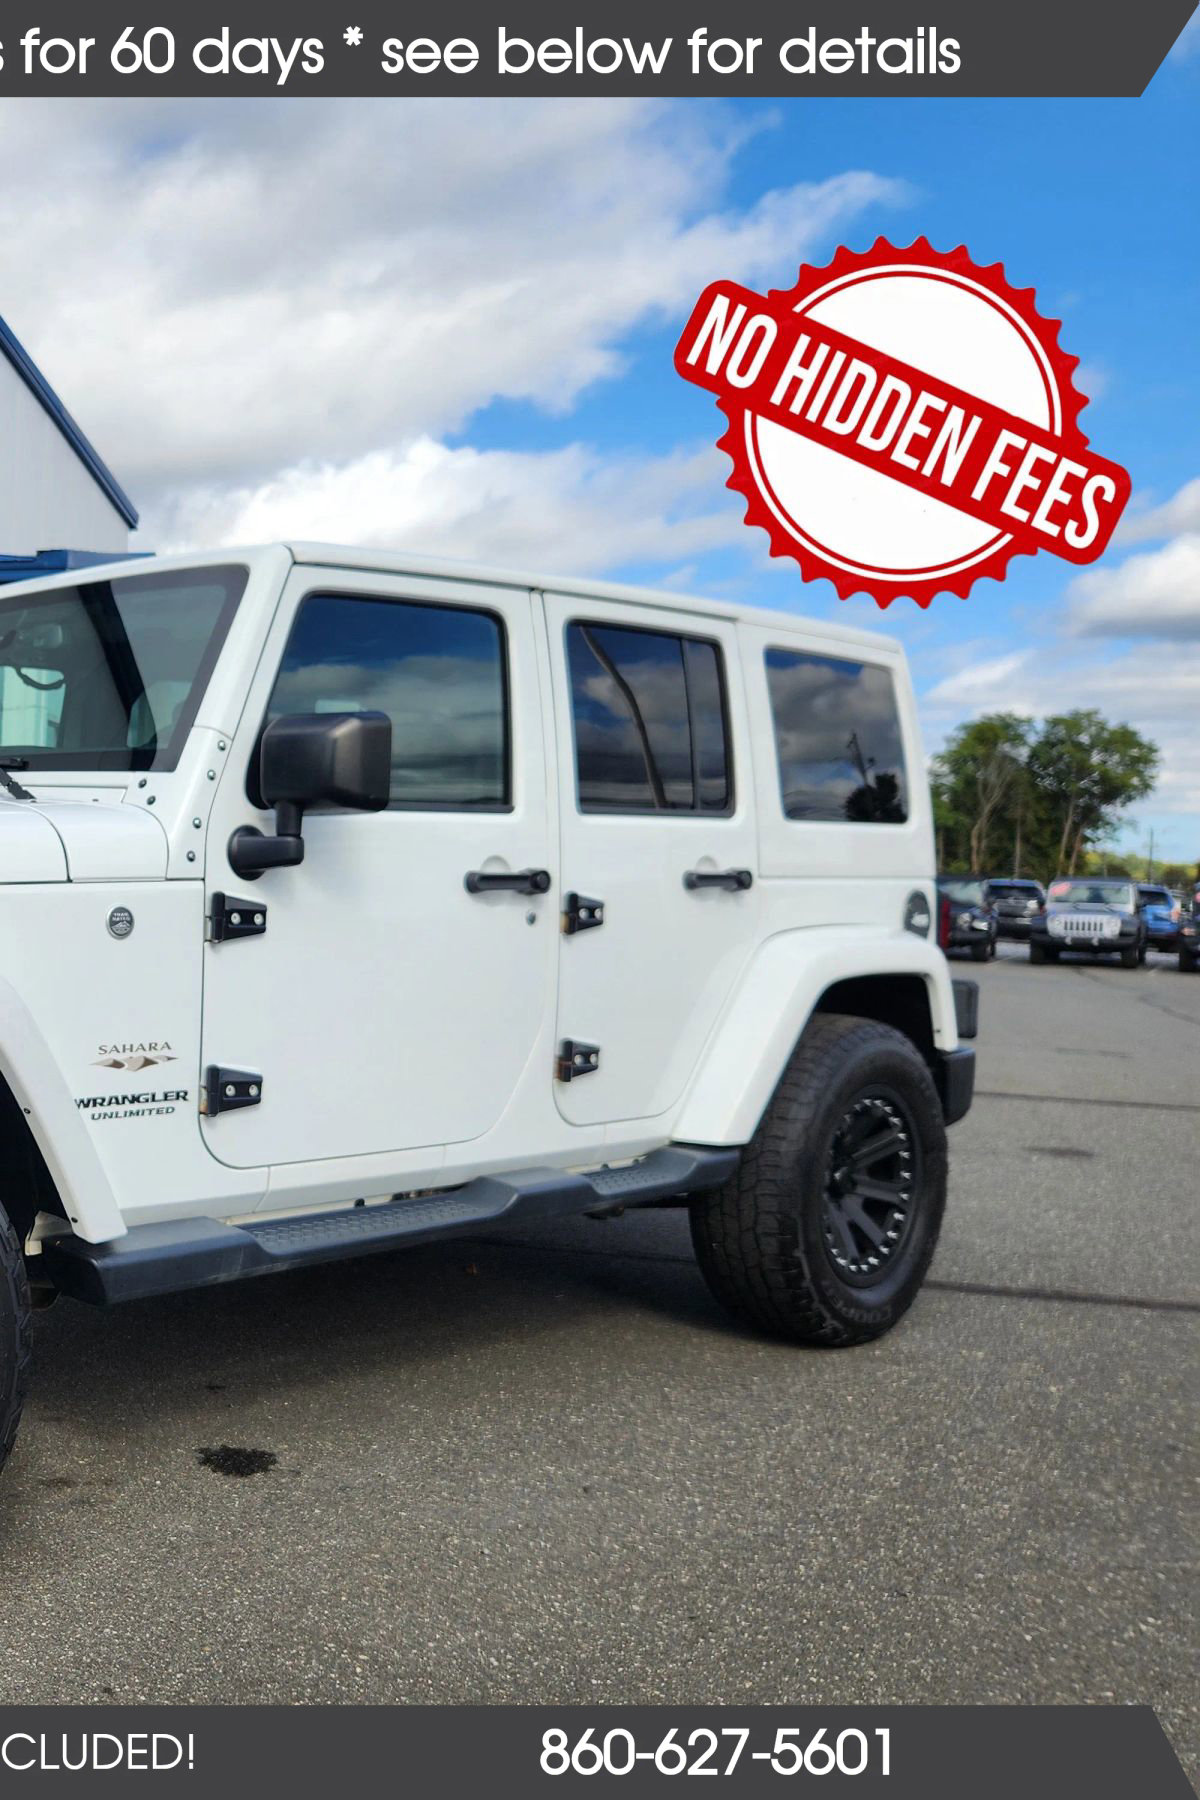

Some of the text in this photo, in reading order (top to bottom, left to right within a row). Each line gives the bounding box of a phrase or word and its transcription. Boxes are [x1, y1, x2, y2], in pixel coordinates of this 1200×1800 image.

[97, 1041, 172, 1055] SAHARA
[74, 1089, 189, 1109] WRANGLER
[90, 1106, 176, 1121] UNLIMITED
